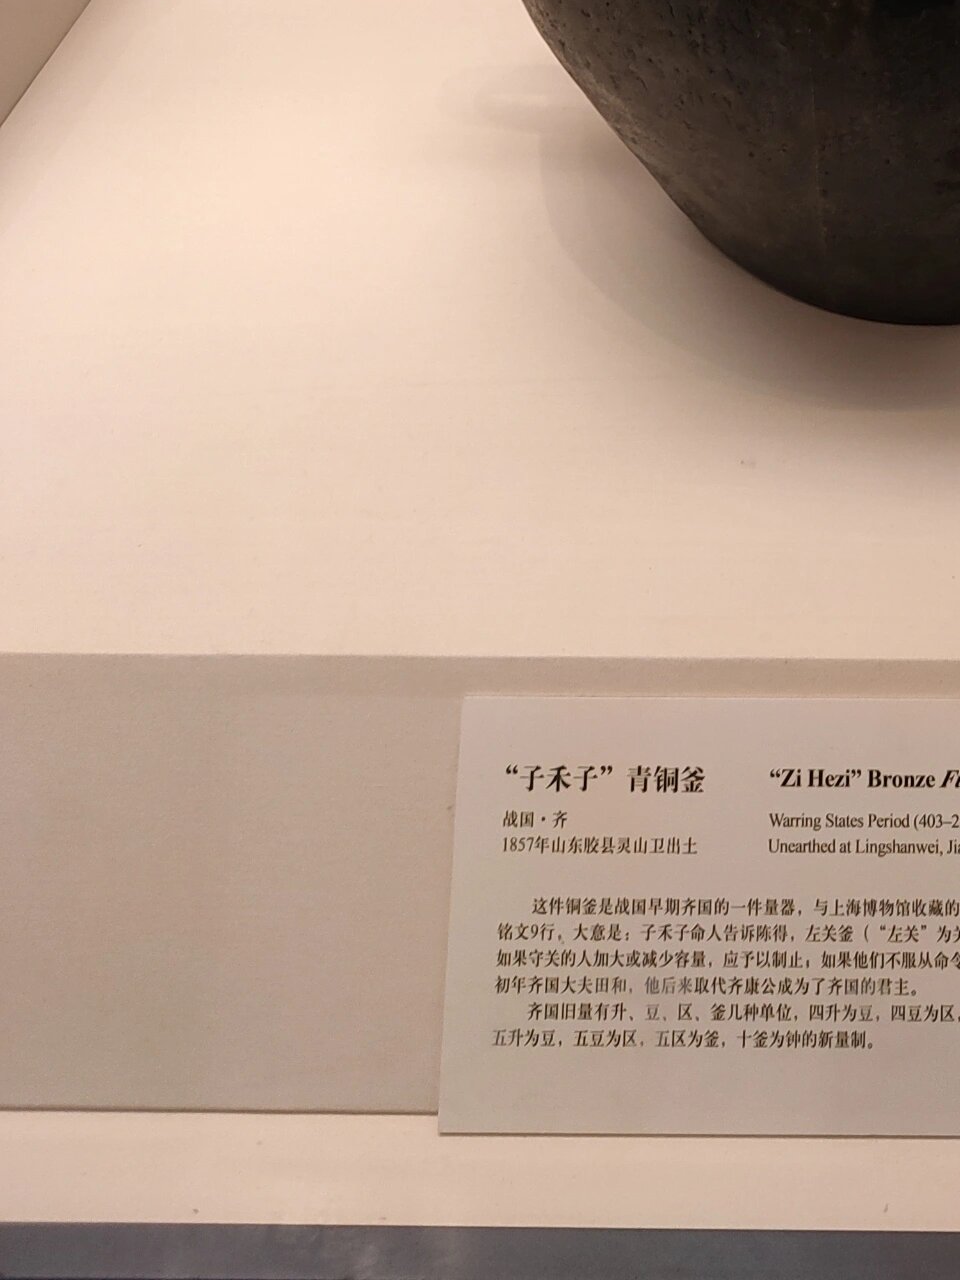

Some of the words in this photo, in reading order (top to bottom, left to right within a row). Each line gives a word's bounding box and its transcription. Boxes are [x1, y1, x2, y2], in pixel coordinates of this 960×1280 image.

[866, 768, 936, 789] Bronze
[768, 812, 822, 832] Warring
[824, 812, 865, 829] States
[867, 812, 911, 829] Period
[502, 834, 698, 856] 1857年山东胶县灵山卫出土
[768, 837, 836, 854] Unearthed
[838, 839, 852, 855] at
[855, 838, 944, 858] Lingshanwei,
